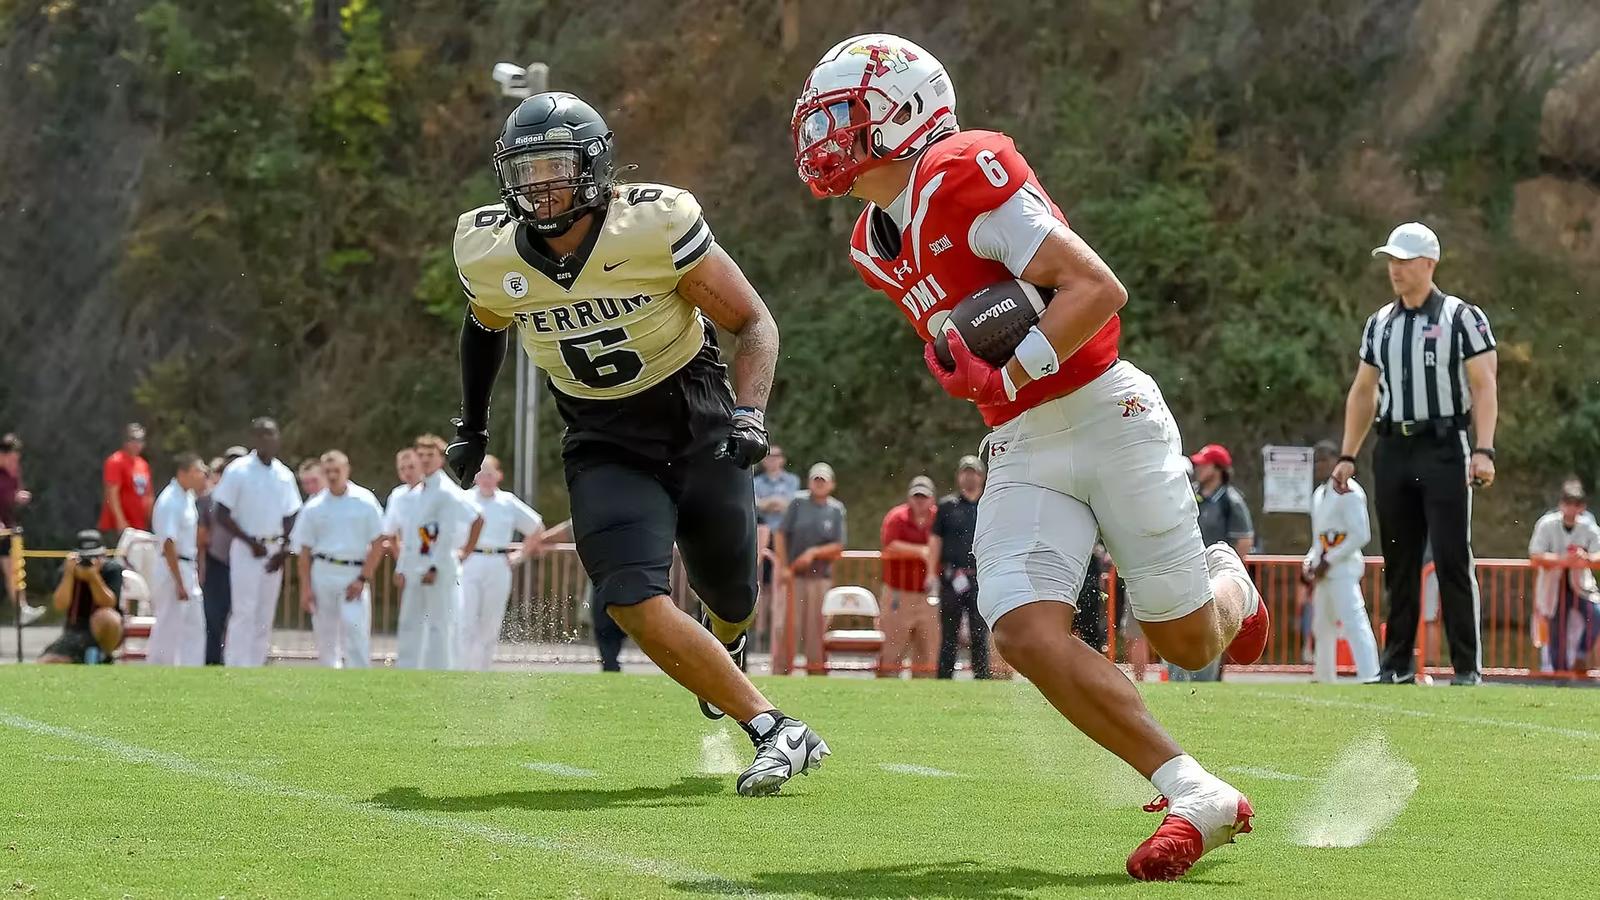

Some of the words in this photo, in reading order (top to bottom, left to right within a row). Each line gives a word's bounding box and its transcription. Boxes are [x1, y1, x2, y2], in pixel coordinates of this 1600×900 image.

[515, 133, 544, 145] Riddell
[976, 149, 1009, 188] 6
[513, 293, 653, 333] FERRUM
[901, 273, 947, 321] VMI
[970, 298, 1018, 328] Wilson
[558, 327, 645, 388] 6
[1424, 351, 1436, 367] R
